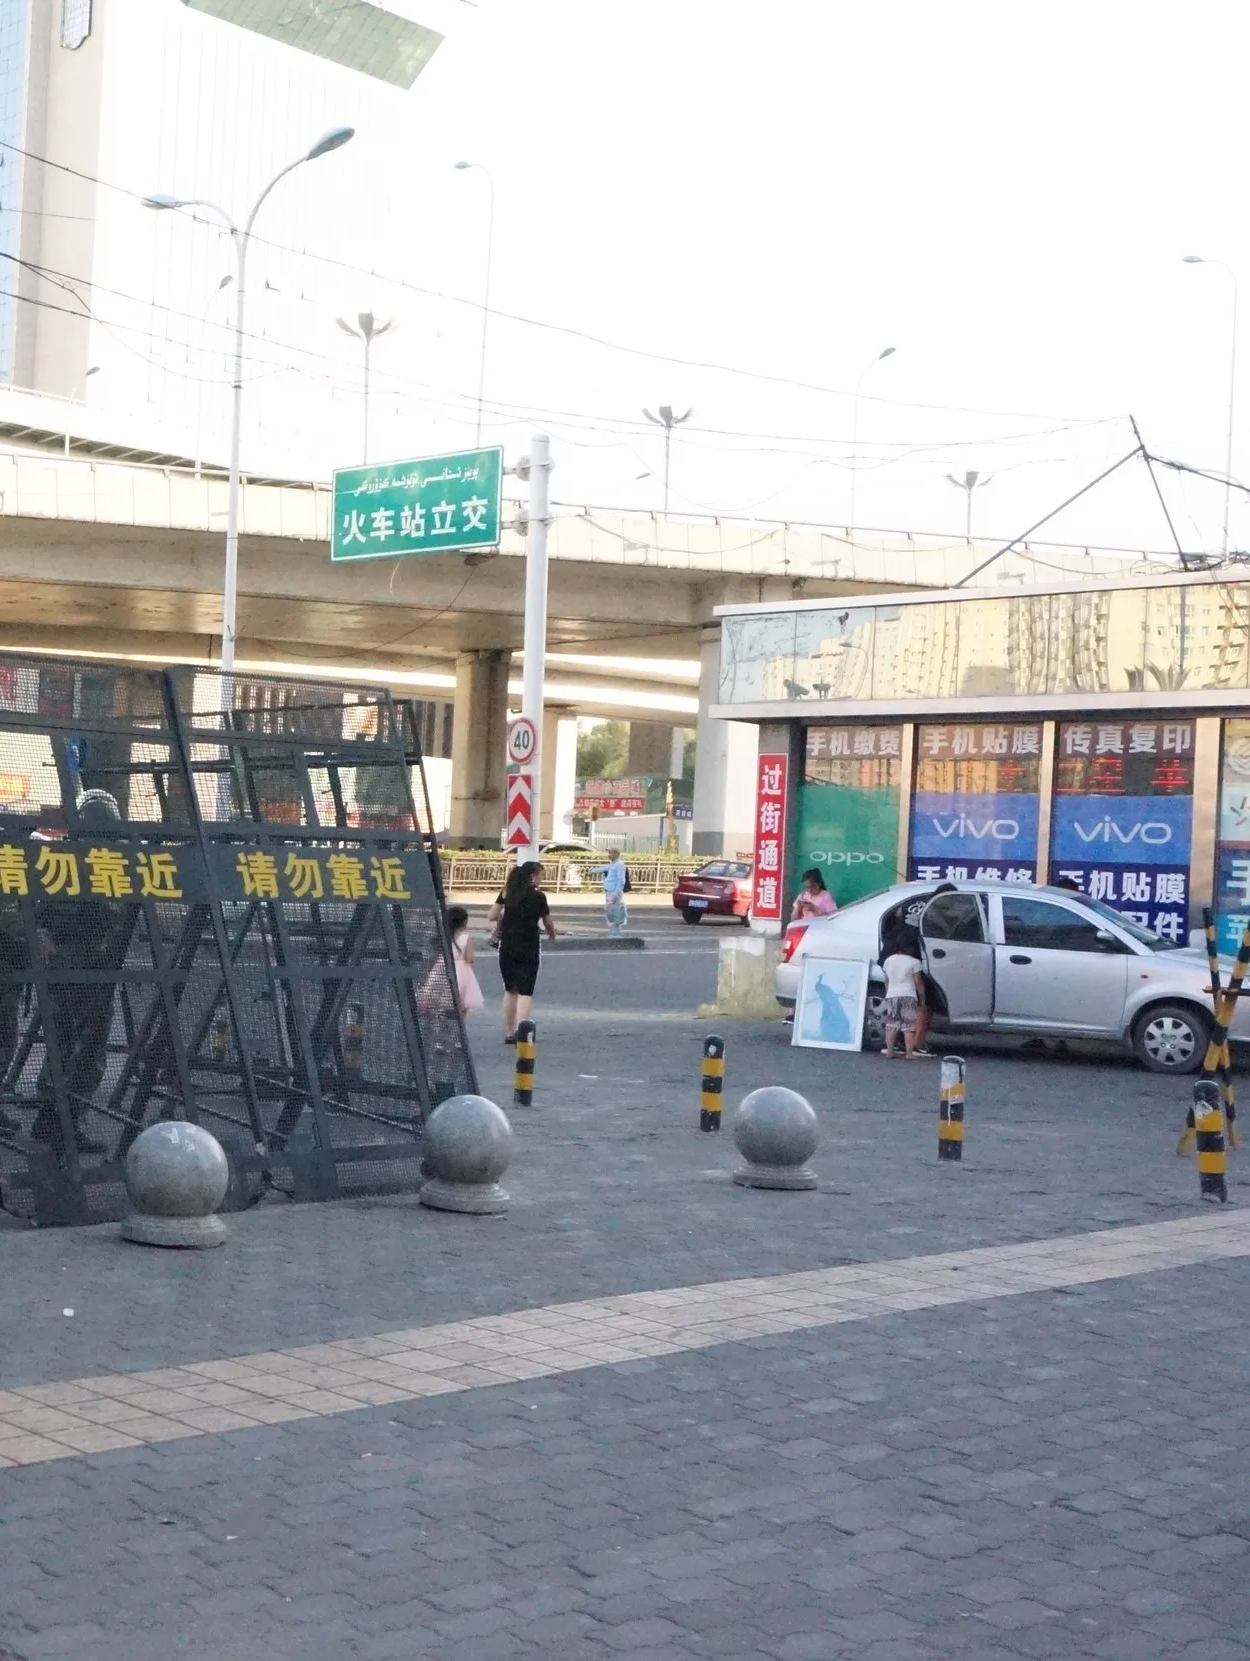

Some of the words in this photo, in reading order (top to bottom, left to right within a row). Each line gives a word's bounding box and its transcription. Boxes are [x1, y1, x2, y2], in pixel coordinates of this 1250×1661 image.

[342, 495, 488, 545] 火车站立交
[514, 730, 530, 750] 40
[806, 730, 899, 756] 手机缴费
[923, 727, 1040, 755] 手机贴膜
[1065, 724, 1192, 754] 传真复印
[756, 763, 782, 909] 过街通道
[932, 812, 1020, 840] vivo
[1073, 815, 1172, 844] vivo
[236, 851, 411, 899] 请勿靠近
